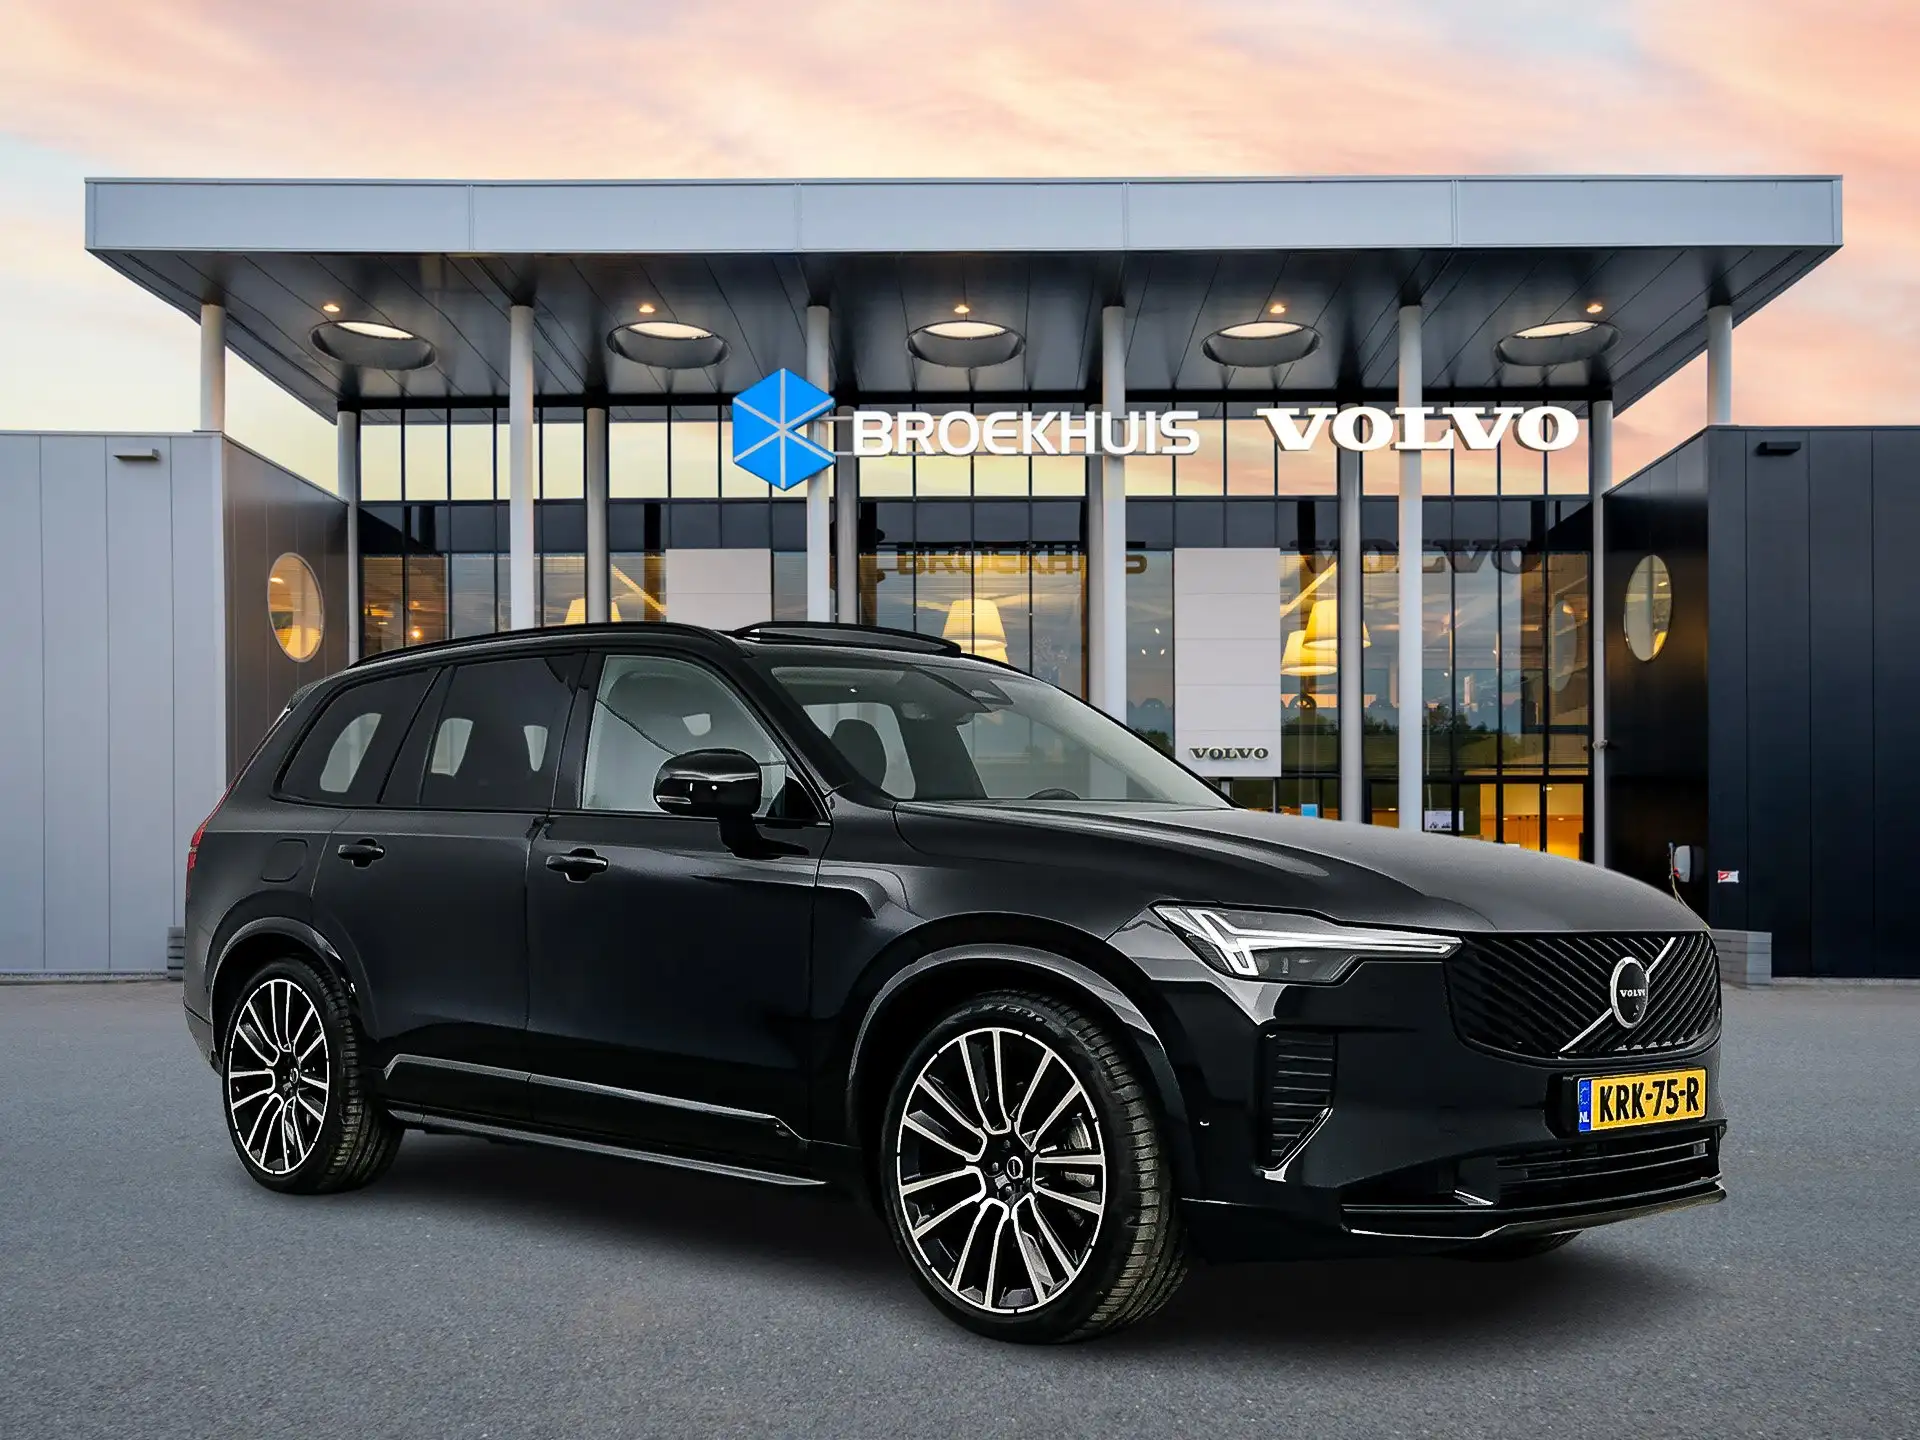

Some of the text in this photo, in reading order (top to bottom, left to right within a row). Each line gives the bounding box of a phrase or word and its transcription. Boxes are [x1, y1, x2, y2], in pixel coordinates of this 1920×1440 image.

[852, 411, 1200, 456] BROEKHUIS
[1253, 406, 1580, 451] VOLVO
[1189, 747, 1269, 760] VOLVO
[1579, 1112, 1590, 1123] NL
[1599, 1076, 1700, 1123] KRK-75-R
